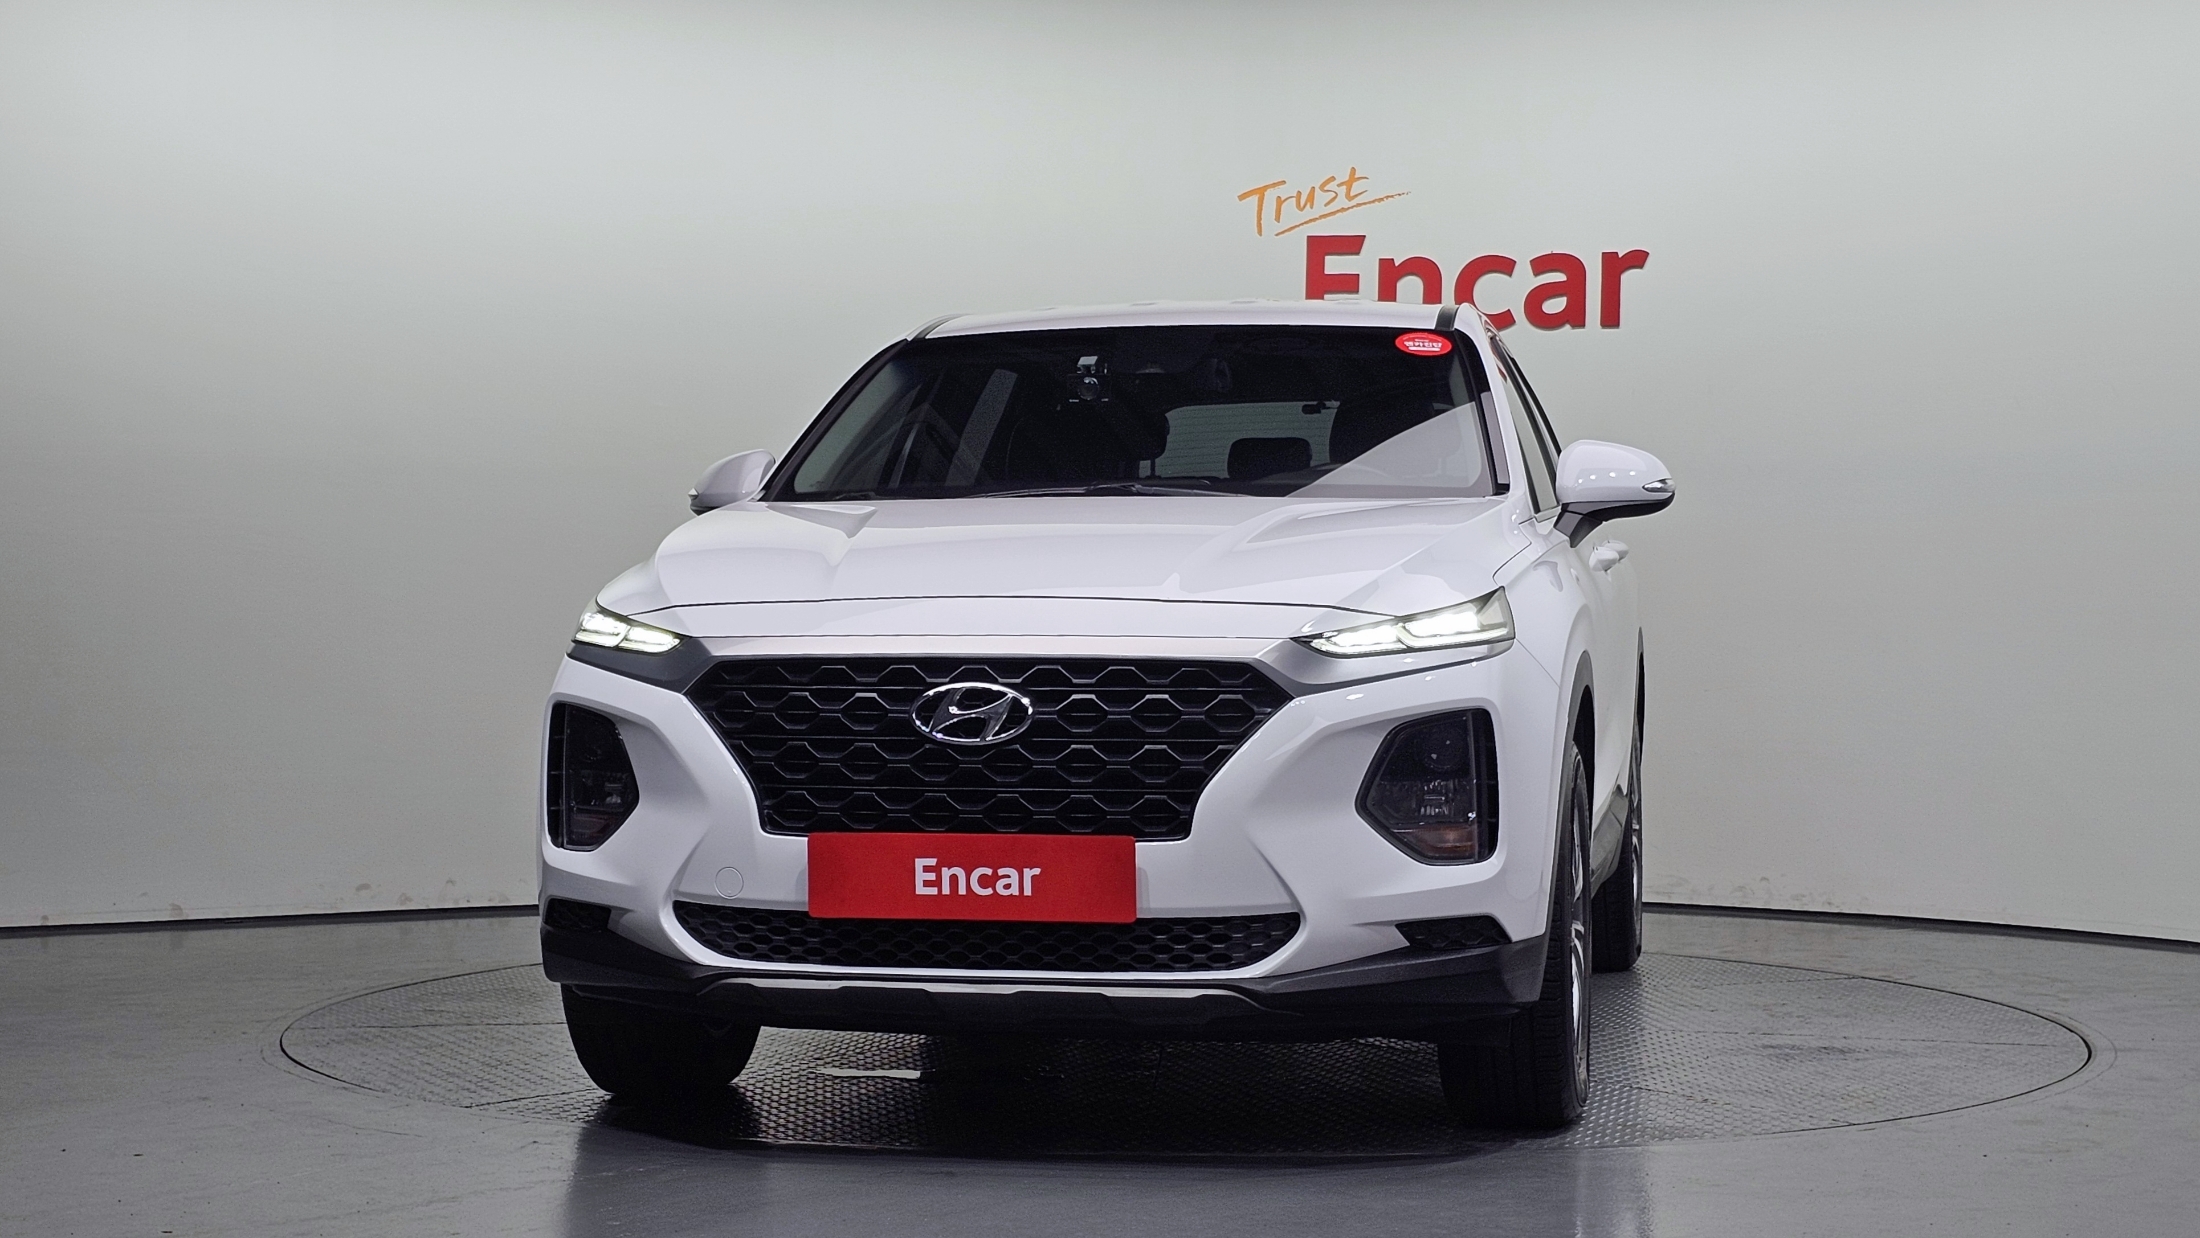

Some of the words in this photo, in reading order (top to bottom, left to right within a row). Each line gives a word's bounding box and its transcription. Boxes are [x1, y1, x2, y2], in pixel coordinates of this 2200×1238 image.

[1237, 167, 1369, 236] Trust
[1305, 234, 1650, 330] Encar
[915, 858, 1042, 897] Encar
